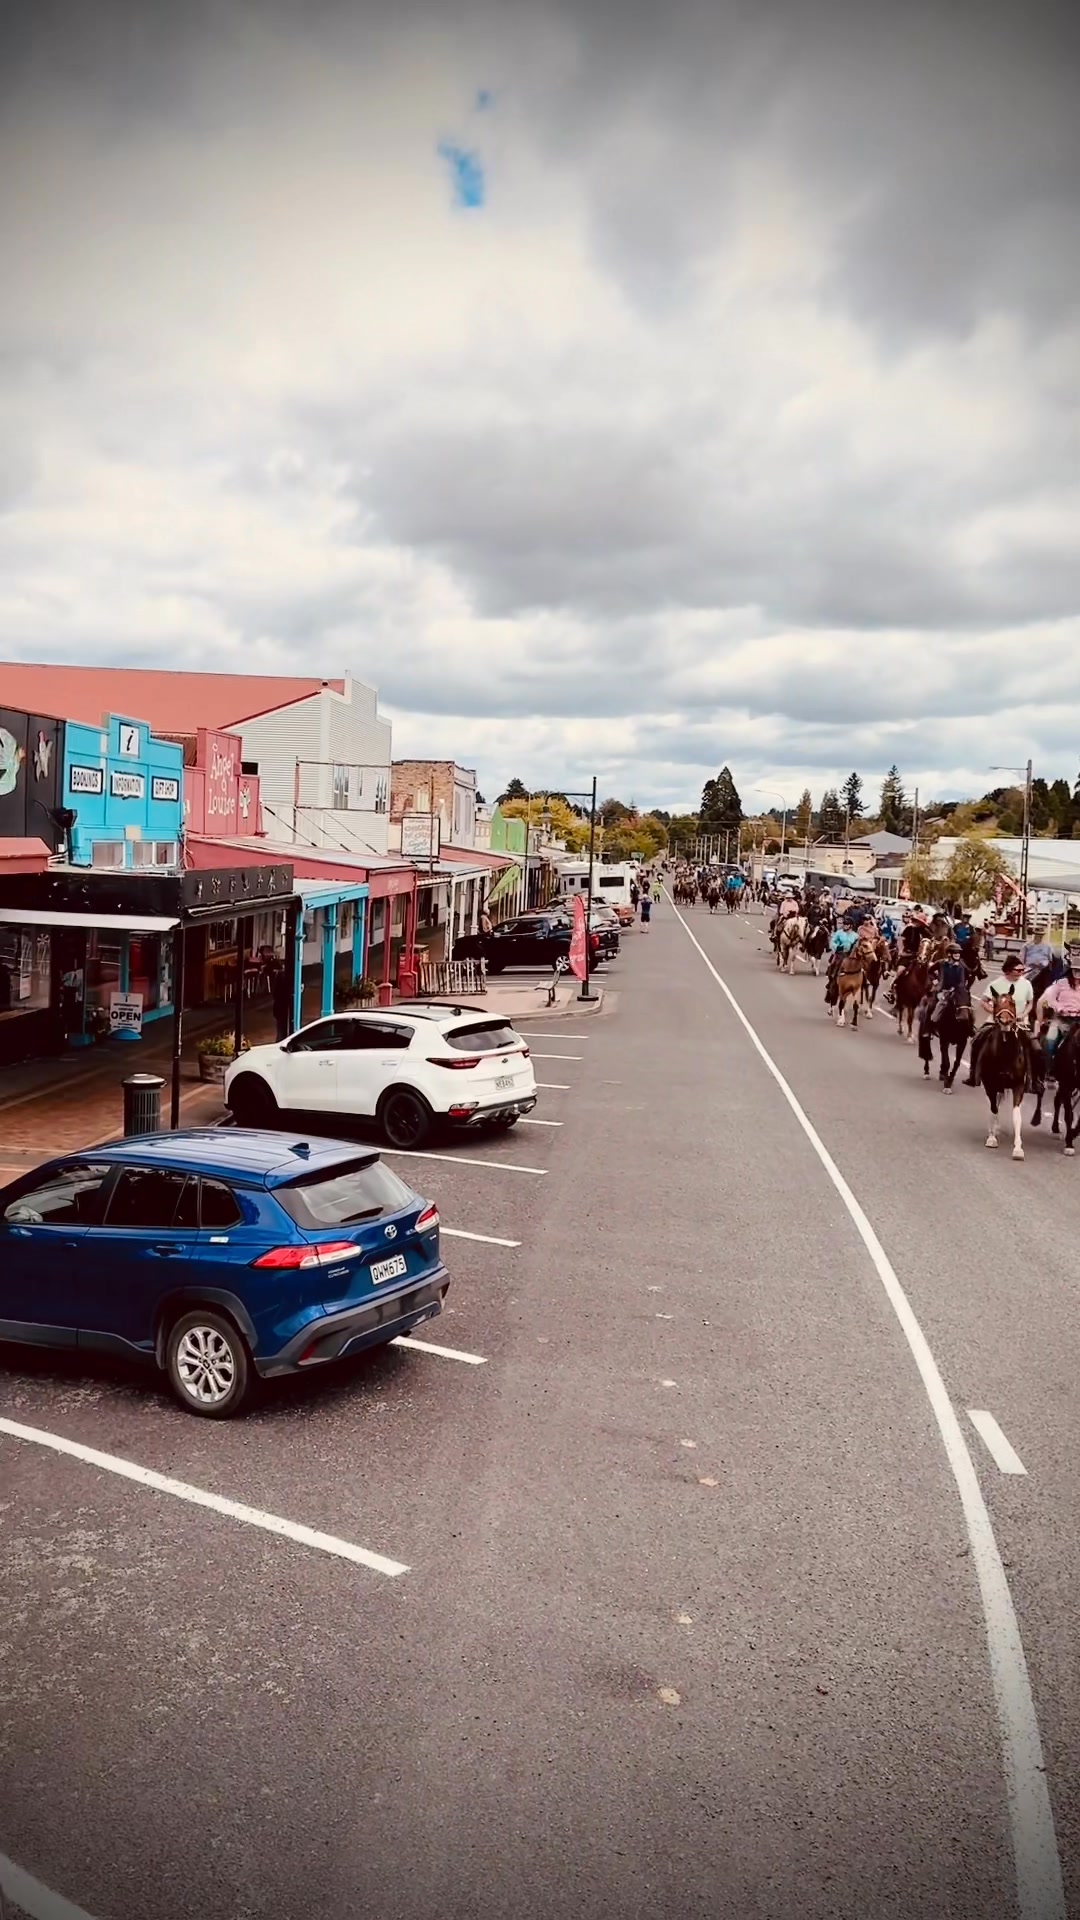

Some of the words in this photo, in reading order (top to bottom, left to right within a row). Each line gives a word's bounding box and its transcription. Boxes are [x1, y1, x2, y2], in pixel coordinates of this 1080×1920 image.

[210, 751, 235, 790] Angel
[73, 771, 99, 788] BOOKINGS
[114, 777, 141, 793] INFORMATION
[155, 781, 165, 795] GIFT
[165, 782, 175, 796] SHOP
[208, 788, 235, 816] Louise
[111, 1011, 141, 1021] OPEN
[372, 1257, 406, 1281] QWM675
